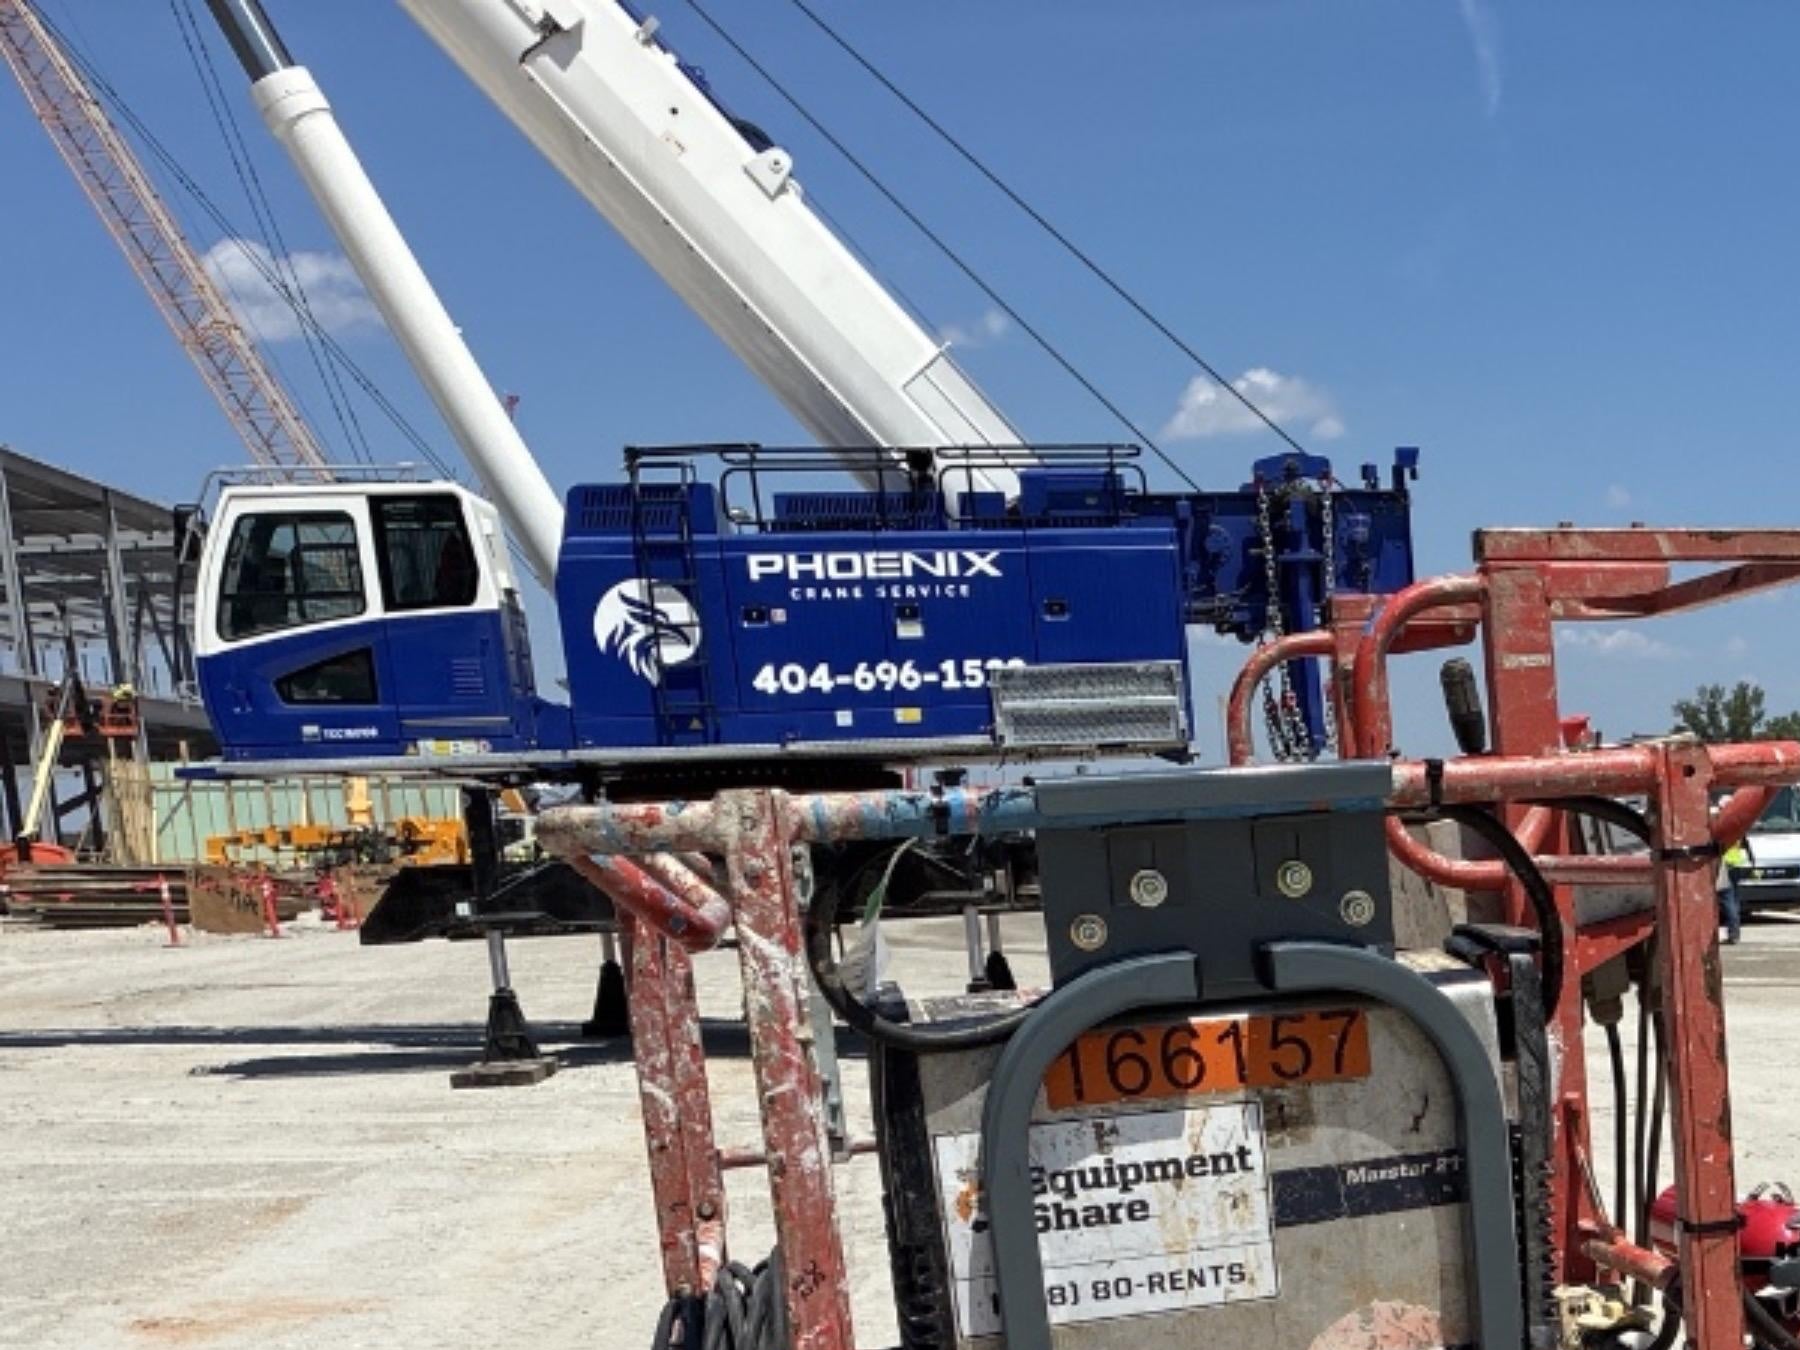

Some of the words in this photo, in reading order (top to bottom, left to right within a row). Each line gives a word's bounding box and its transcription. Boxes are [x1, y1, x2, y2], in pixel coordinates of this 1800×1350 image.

[747, 550, 1002, 581] PHOENIX
[790, 585, 863, 600] CRANE
[875, 584, 970, 599] SERVICE
[1064, 1007, 1362, 1101] 166157
[1091, 1262, 1246, 1300] 80-RENTS
